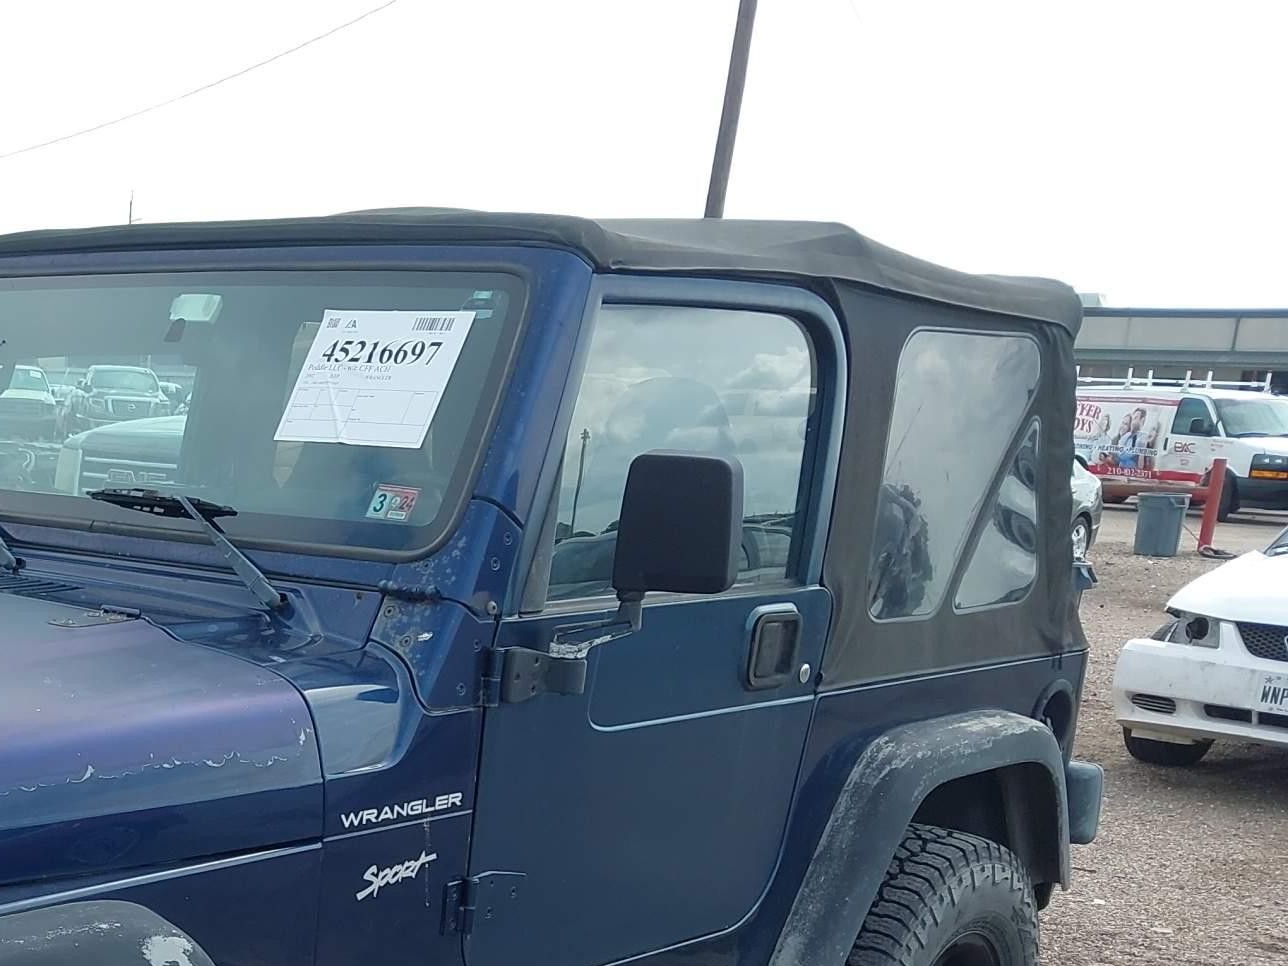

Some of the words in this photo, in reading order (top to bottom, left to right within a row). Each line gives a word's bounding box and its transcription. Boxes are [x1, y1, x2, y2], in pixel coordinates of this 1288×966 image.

[321, 338, 444, 365] 45216697
[373, 493, 387, 512] 3
[340, 792, 462, 828] WRANGLER
[356, 850, 438, 901] Sport
